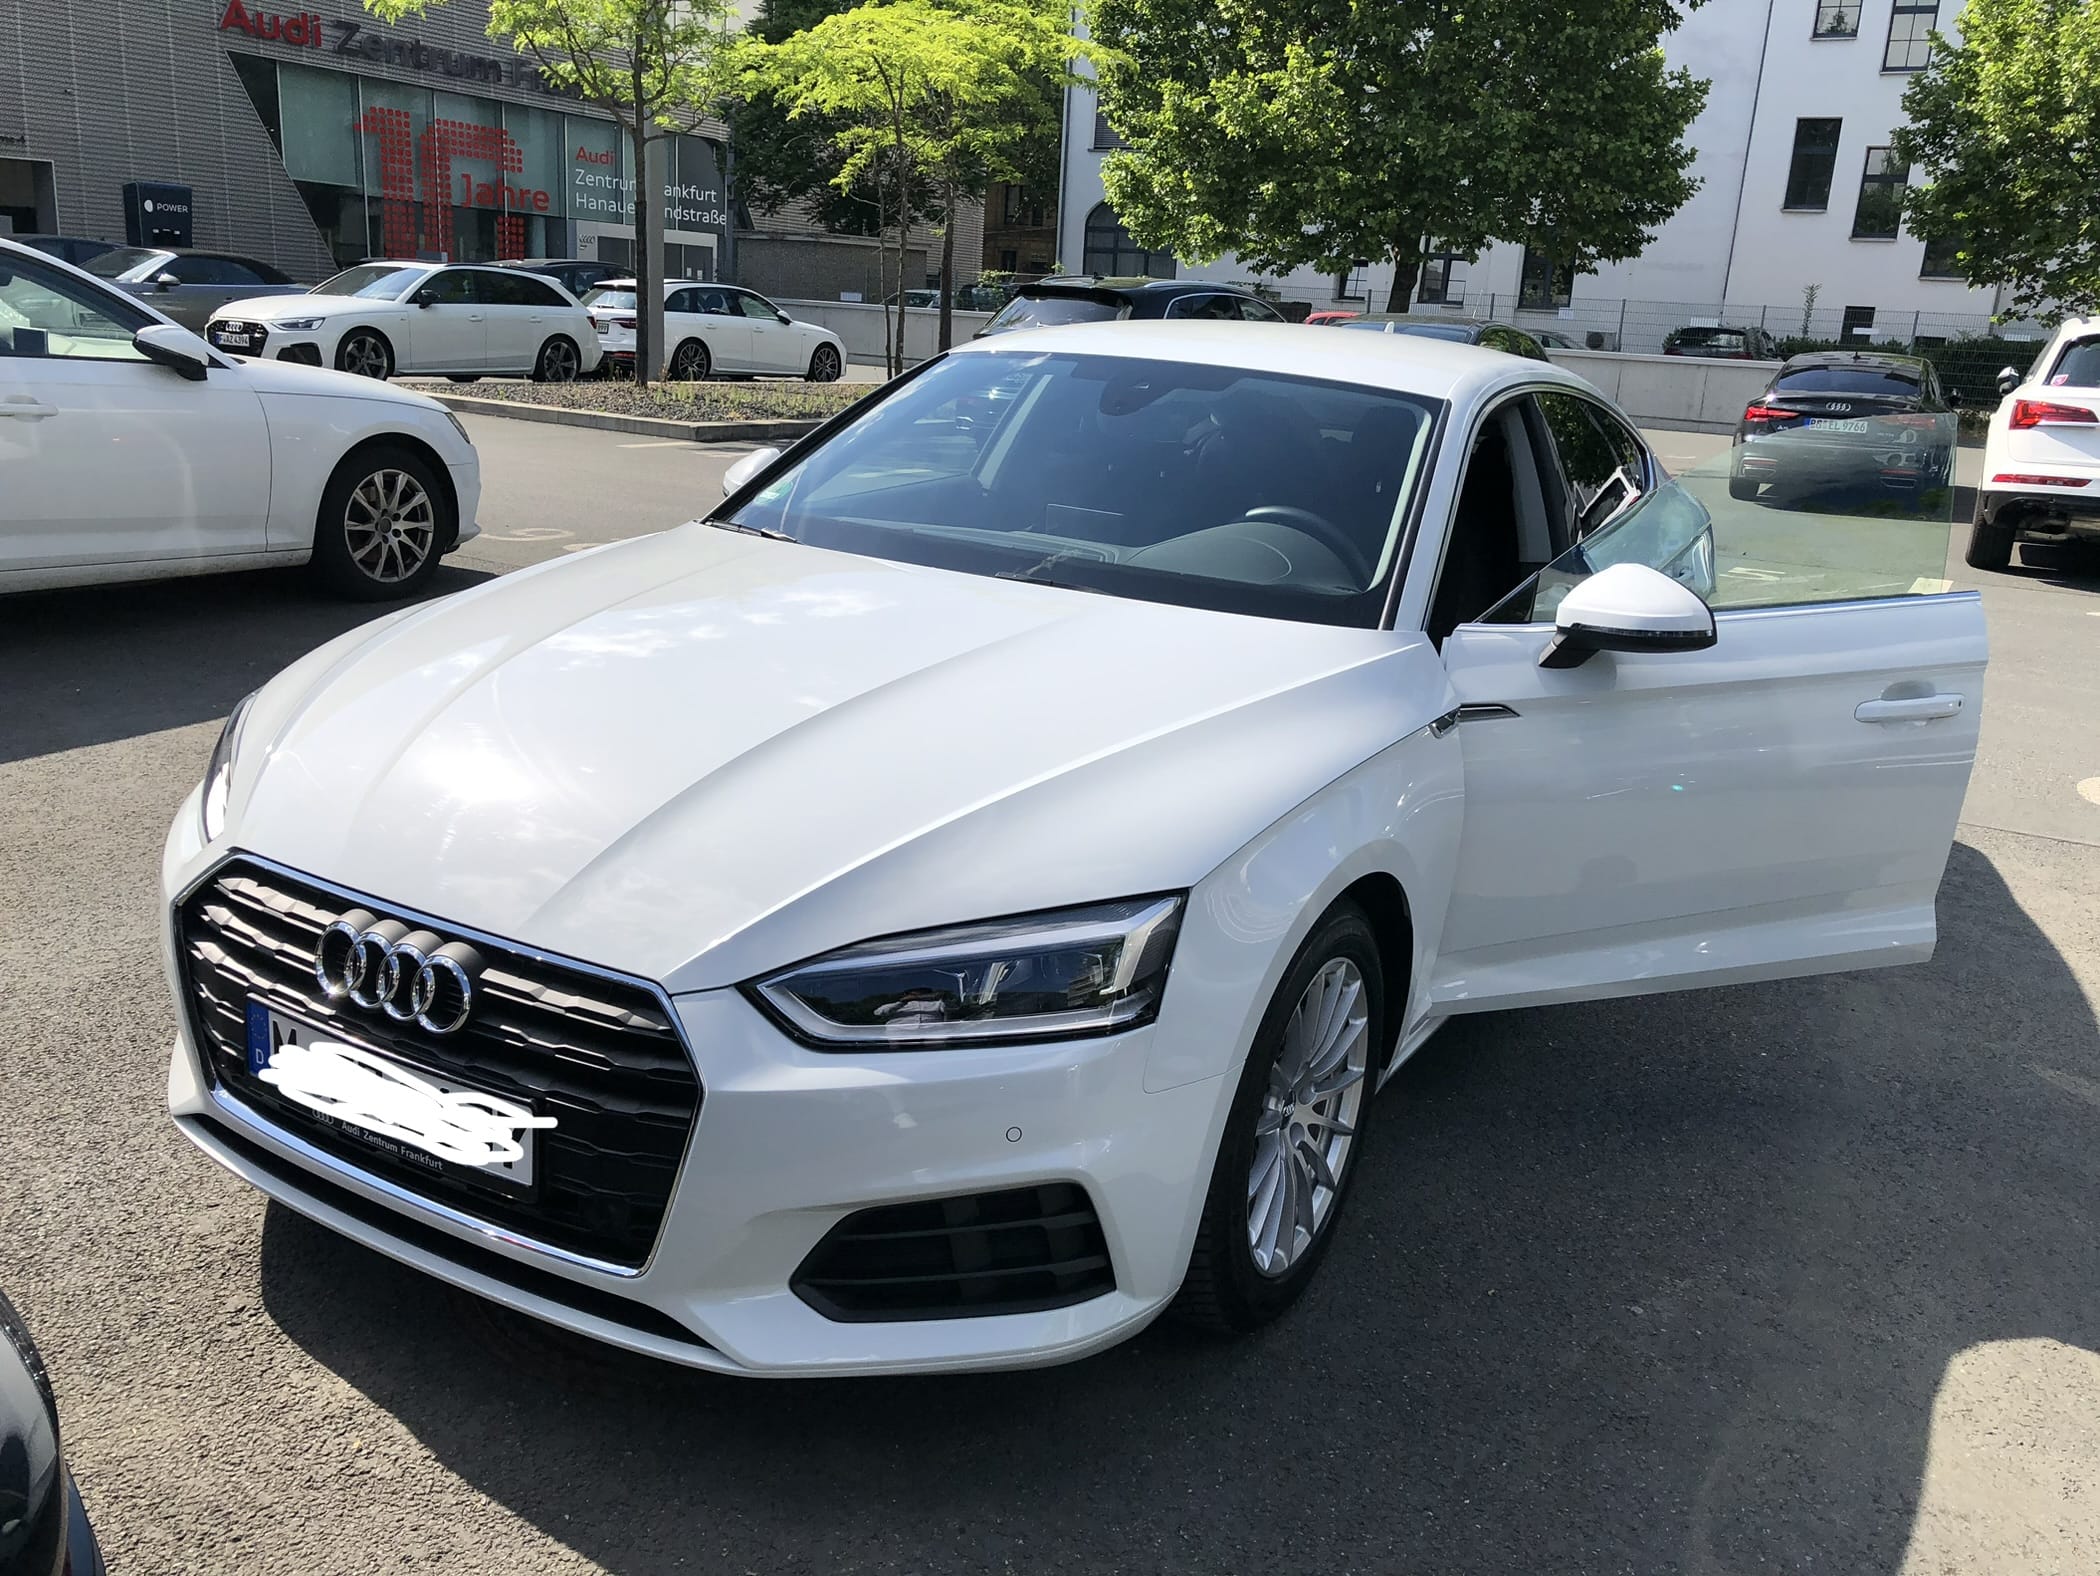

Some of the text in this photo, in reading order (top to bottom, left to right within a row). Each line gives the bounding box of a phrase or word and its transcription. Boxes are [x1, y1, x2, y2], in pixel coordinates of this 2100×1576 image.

[221, 0, 322, 48] Audi
[333, 19, 502, 82] Zentrum
[575, 146, 615, 165] Audi
[461, 173, 550, 212] Jahre
[664, 184, 717, 203] ankfurt
[156, 203, 189, 213] POWER
[575, 192, 727, 225] Hanaue ndstraße
[255, 1048, 264, 1065] D
[341, 1120, 443, 1171] Audi Zentrum Frankfurt
